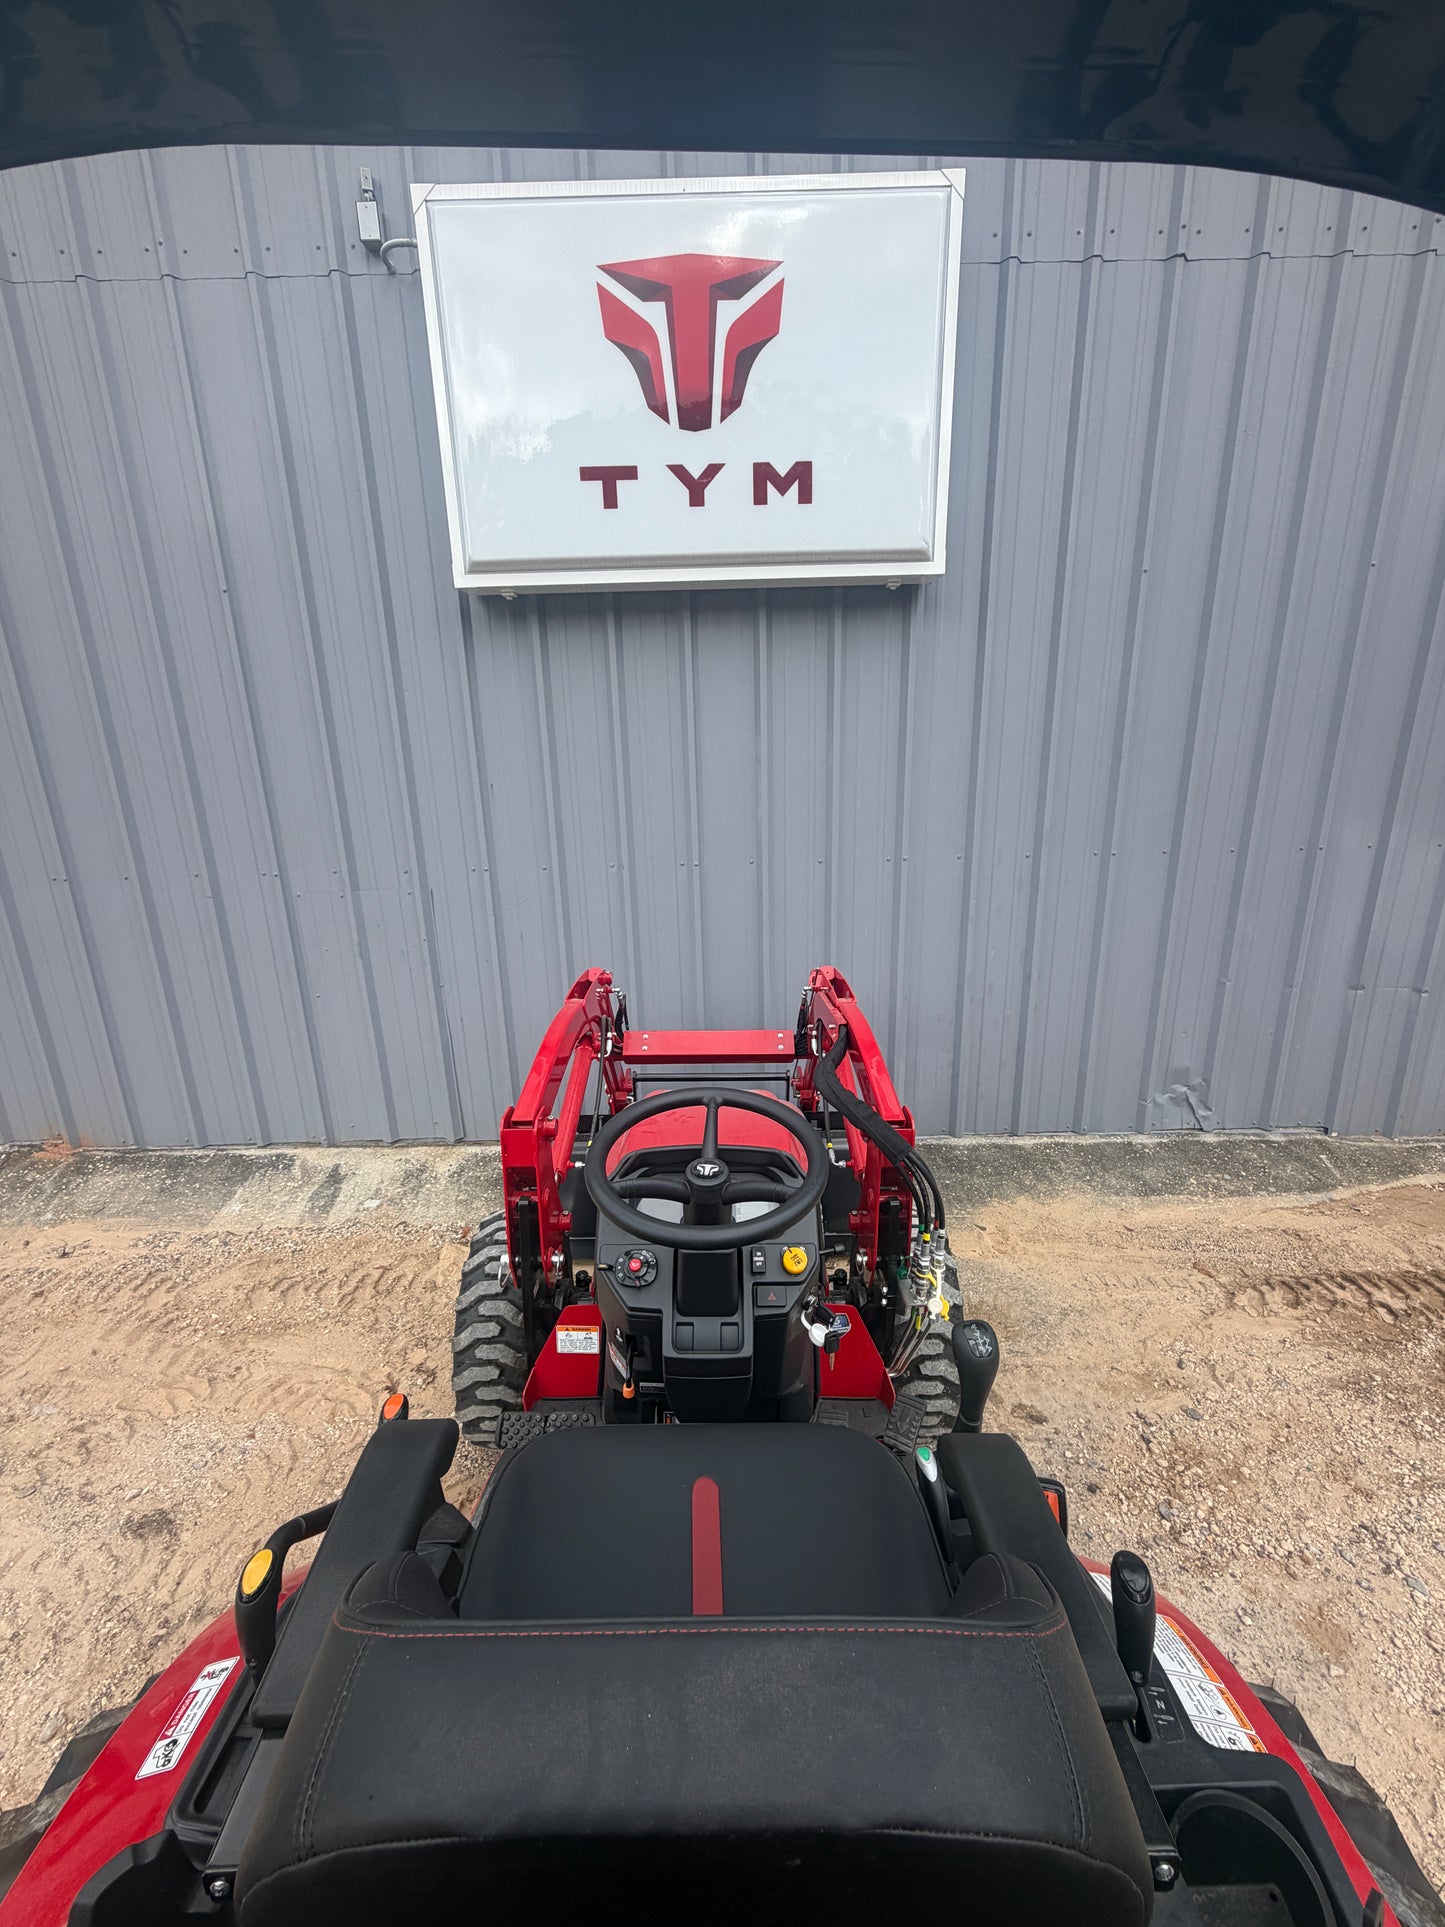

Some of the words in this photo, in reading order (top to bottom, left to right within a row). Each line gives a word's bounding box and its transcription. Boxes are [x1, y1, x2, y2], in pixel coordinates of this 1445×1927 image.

[579, 461, 813, 509] TYM
[171, 1693, 195, 1726] DANGER
[1155, 1699, 1166, 1710] N
